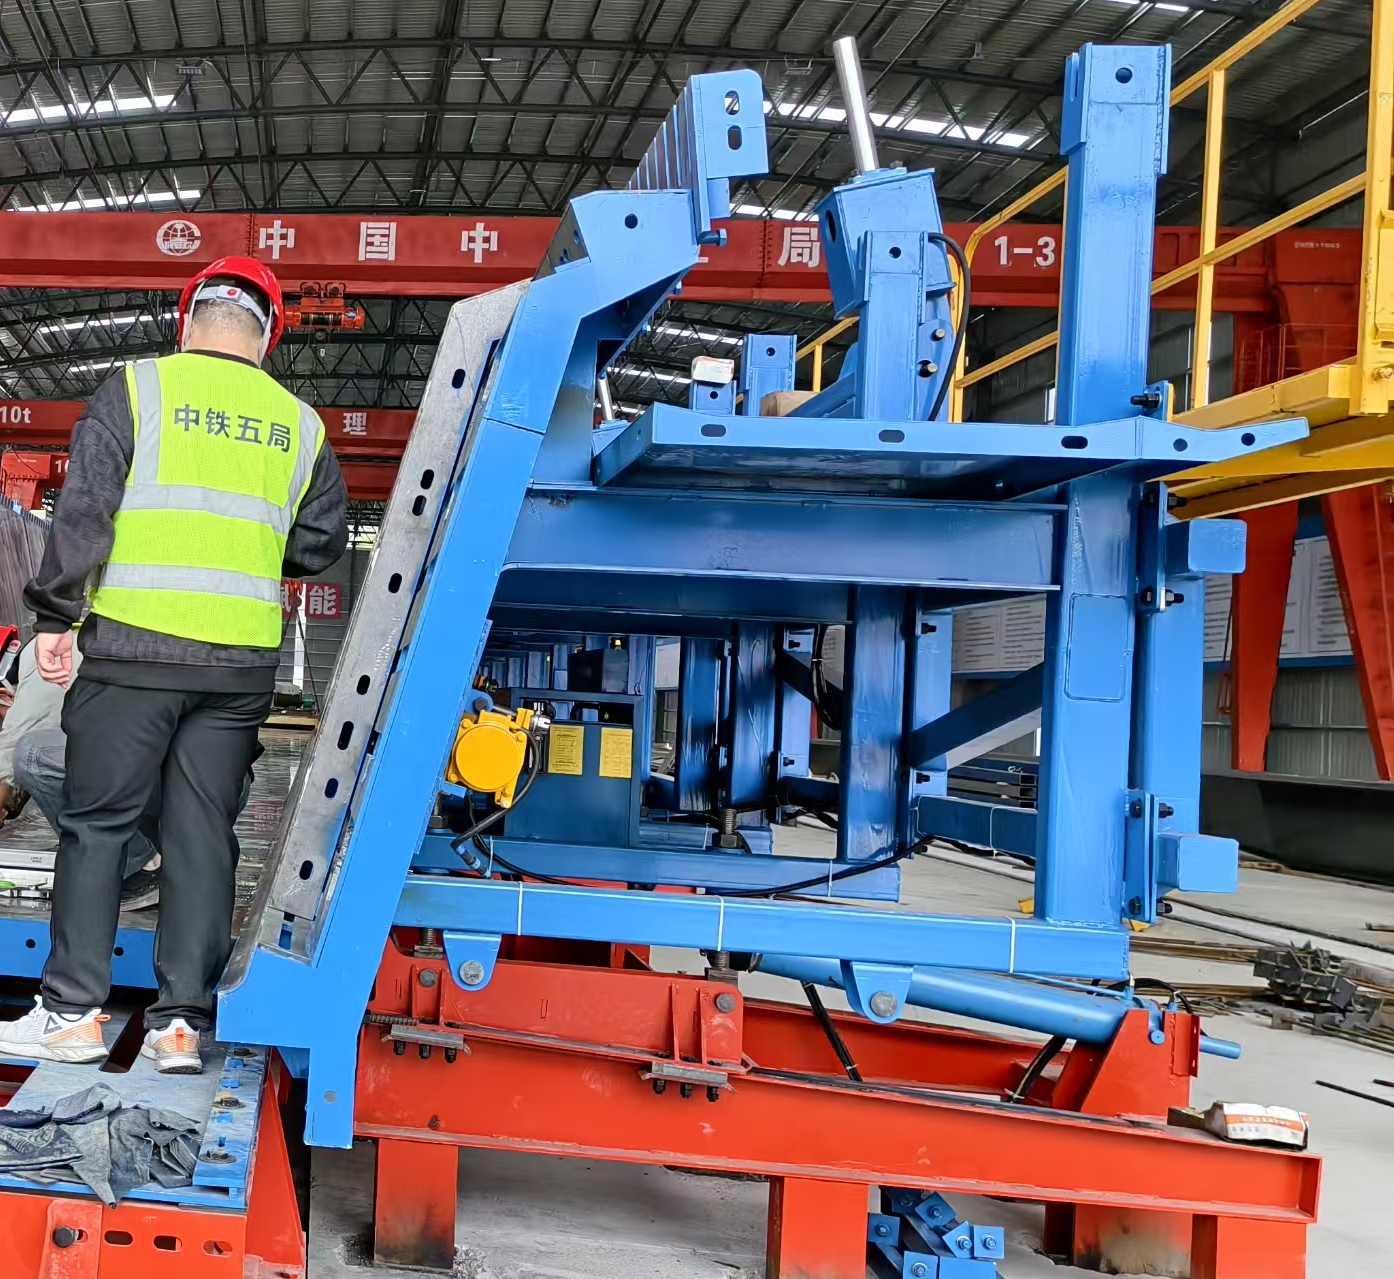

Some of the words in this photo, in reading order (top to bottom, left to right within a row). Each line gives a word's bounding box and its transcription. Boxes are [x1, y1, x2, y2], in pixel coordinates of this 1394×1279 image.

[994, 236, 1056, 266] 1-3
[173, 404, 291, 453] 中铁五局
[343, 412, 367, 436] 理
